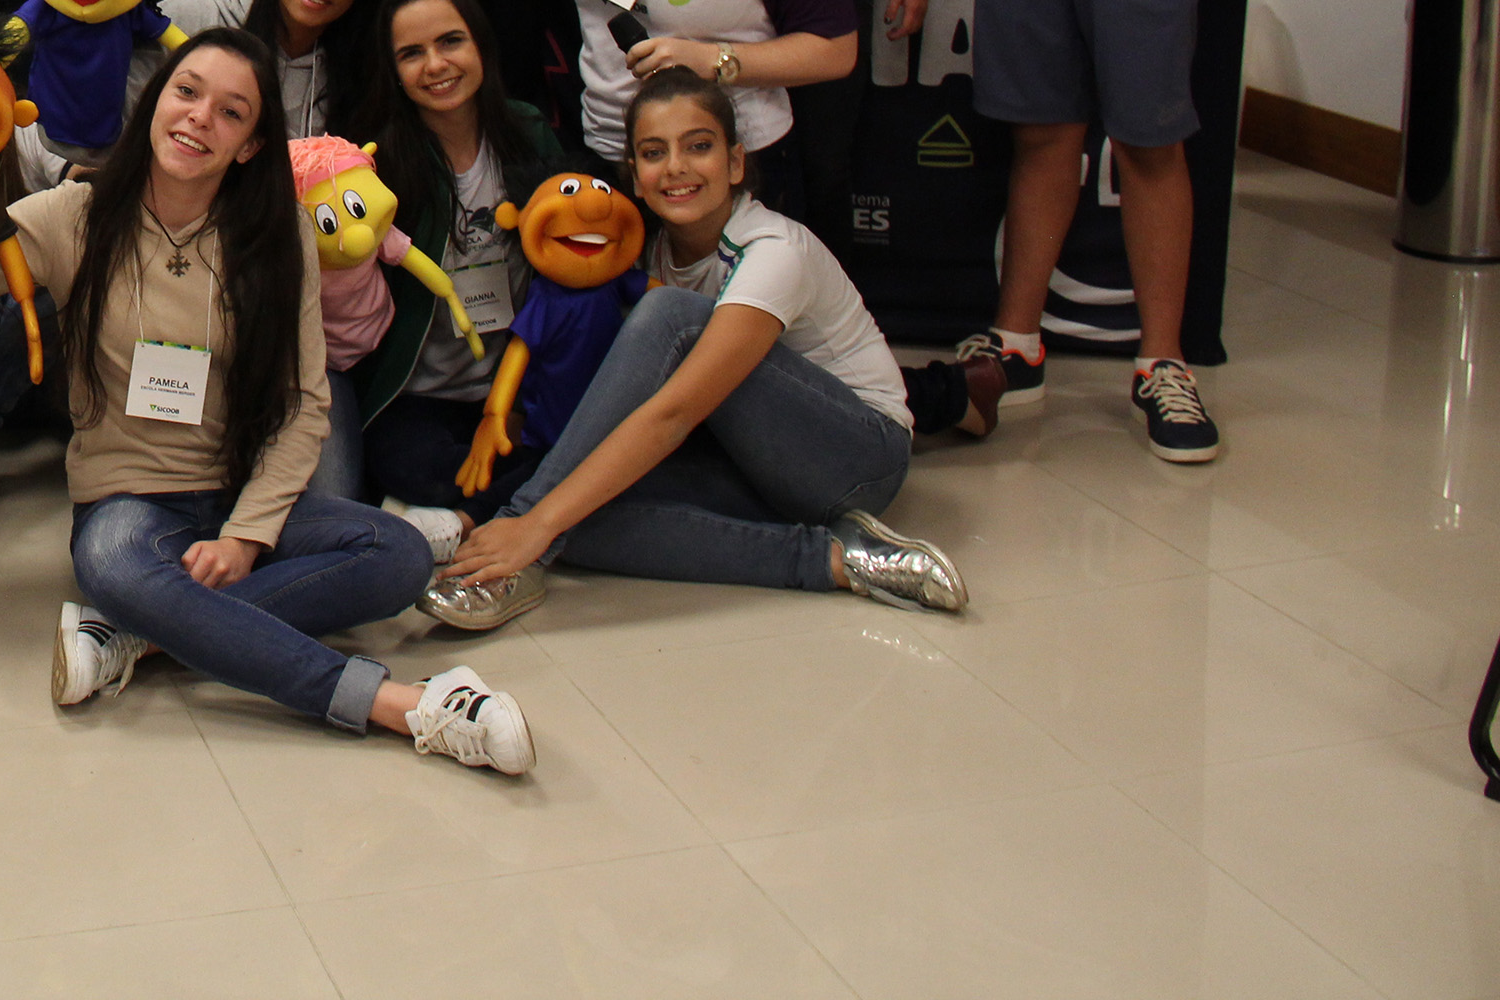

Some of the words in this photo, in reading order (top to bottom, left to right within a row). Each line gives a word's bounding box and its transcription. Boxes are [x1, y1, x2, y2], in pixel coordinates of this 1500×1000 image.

[851, 193, 891, 207] tema
[464, 291, 497, 304] GIANNA
[148, 376, 190, 390] PAMELA
[156, 405, 180, 414] SICOOB
